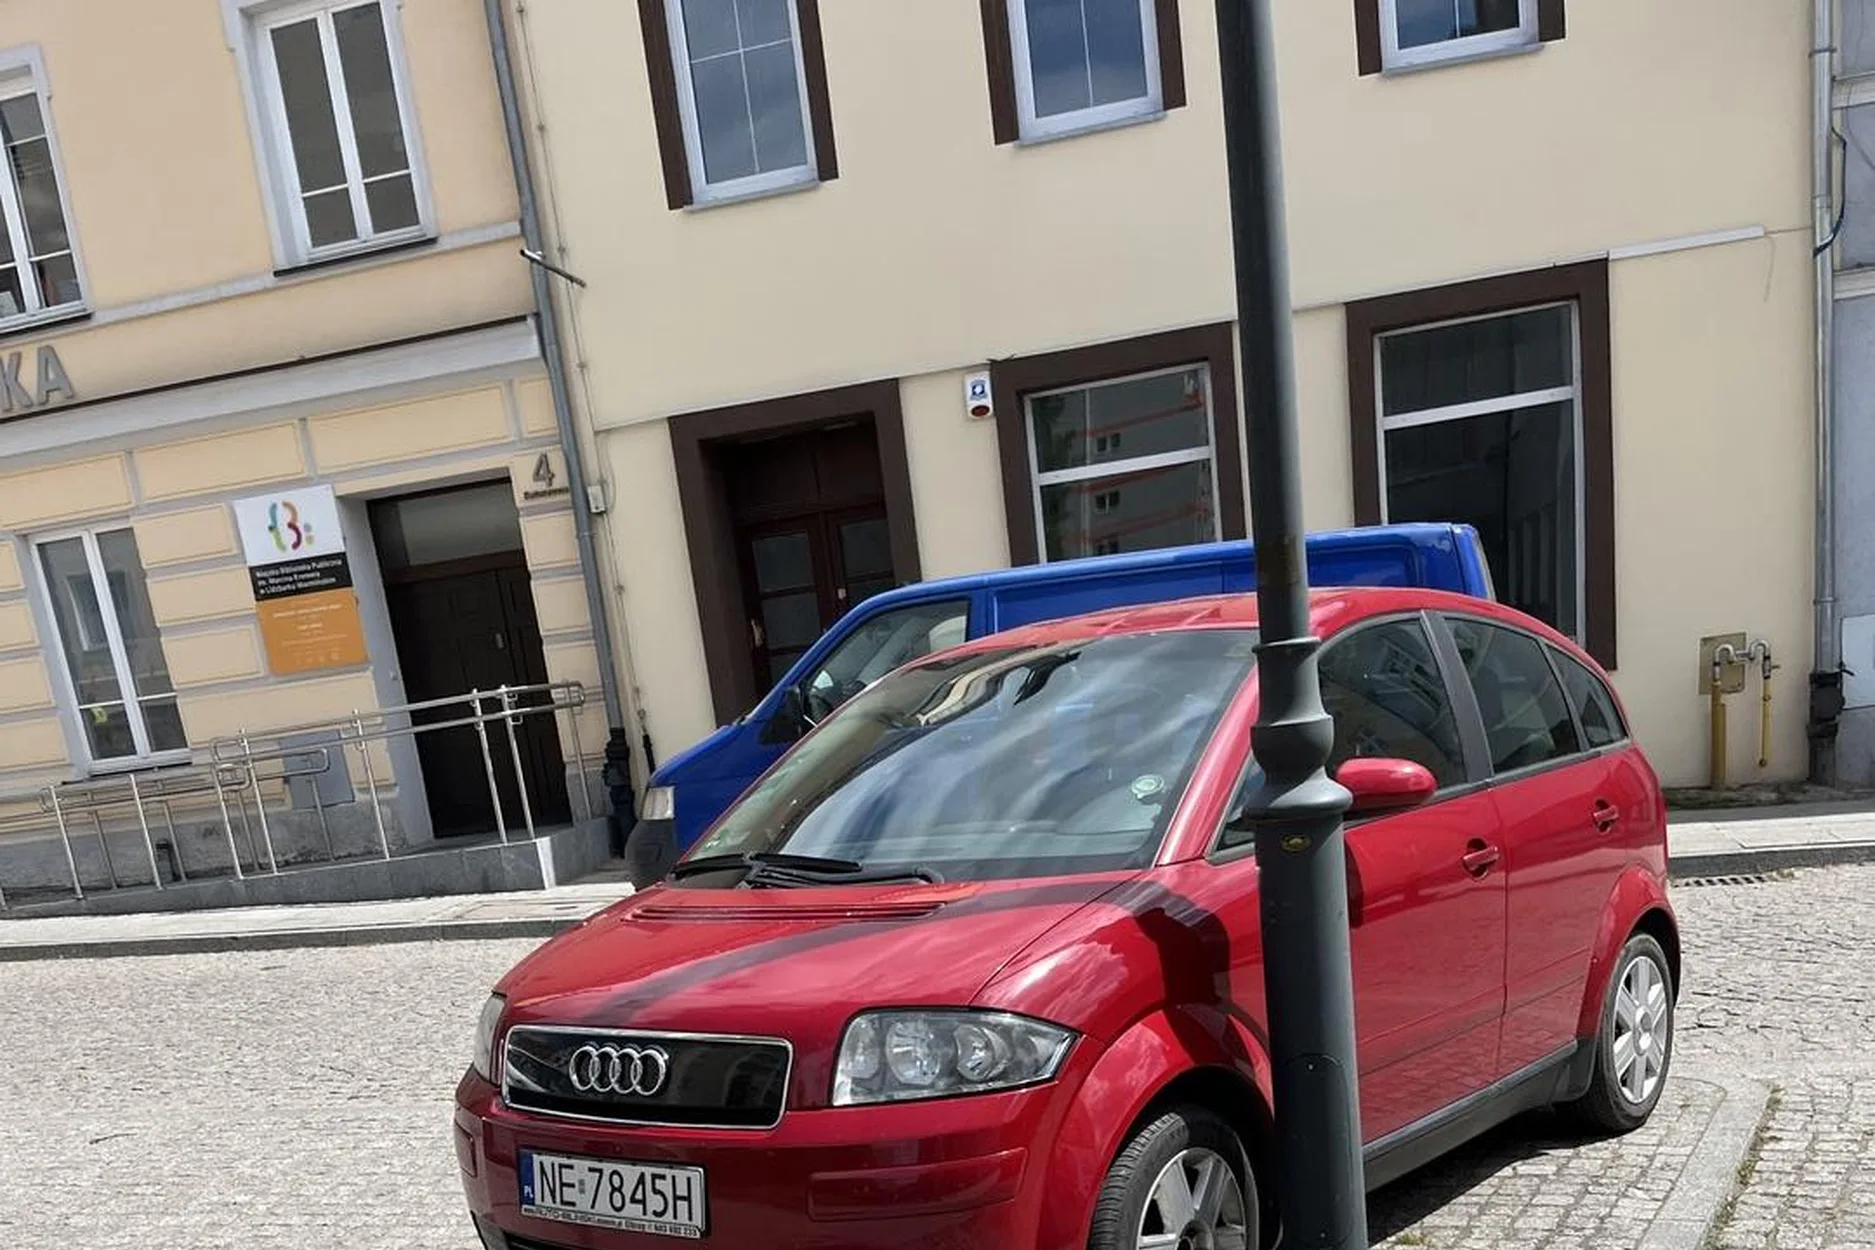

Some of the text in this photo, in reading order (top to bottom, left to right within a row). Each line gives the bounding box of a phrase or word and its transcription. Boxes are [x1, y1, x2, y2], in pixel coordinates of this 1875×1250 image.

[533, 453, 555, 487] 4
[523, 1185, 534, 1198] PL
[539, 1160, 577, 1208] NE
[588, 1167, 694, 1223] 7845H
